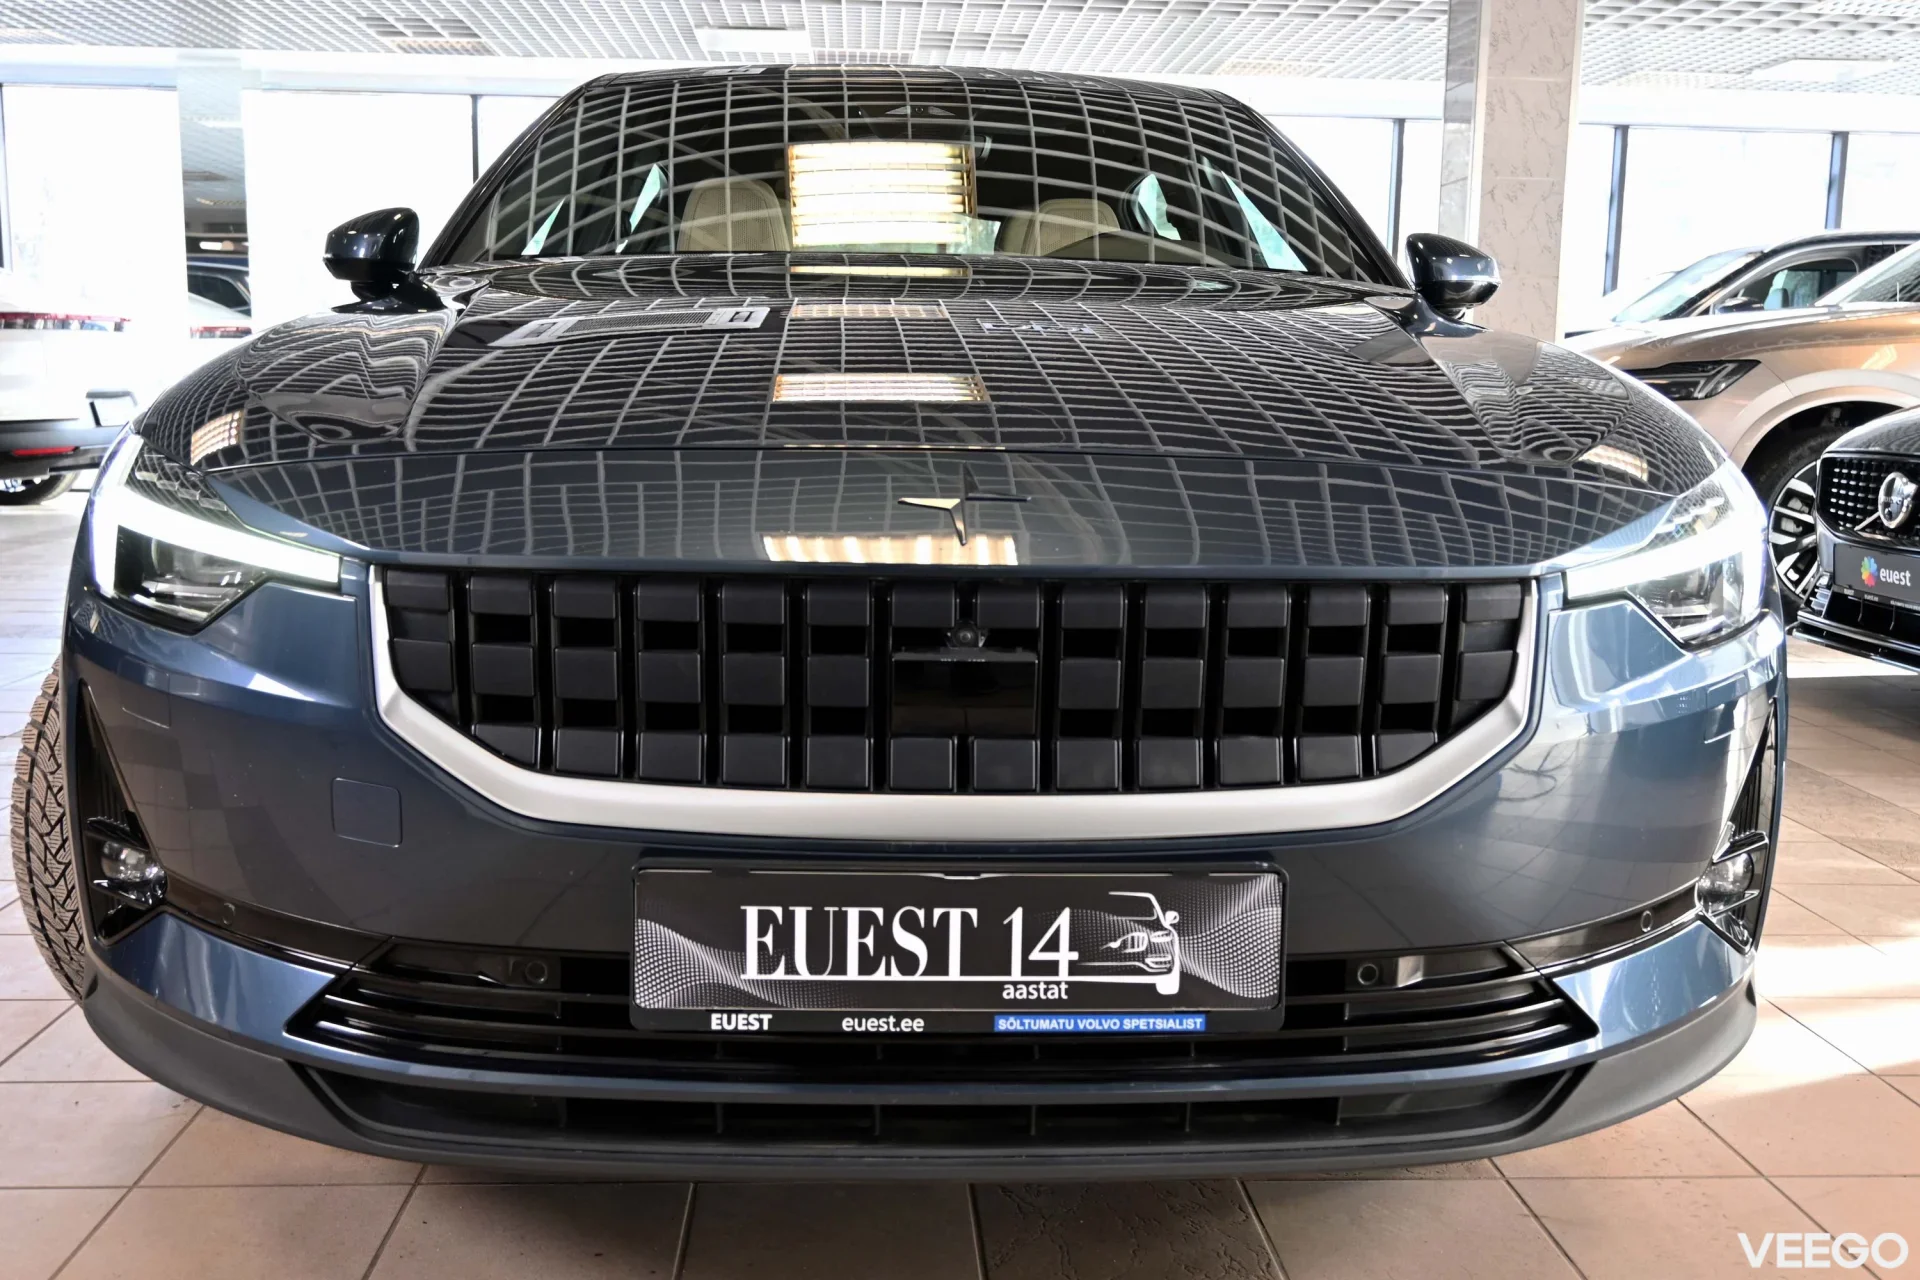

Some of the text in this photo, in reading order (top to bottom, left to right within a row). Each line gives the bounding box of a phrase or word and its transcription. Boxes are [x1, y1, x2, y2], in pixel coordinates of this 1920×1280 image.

[1879, 567, 1912, 587] euest
[740, 906, 1078, 977] EUEST 14
[1002, 982, 1069, 1000] aastat
[710, 1013, 773, 1031] EUEST
[841, 1015, 925, 1034] euest.ee
[998, 1016, 1204, 1030] SÕLTUMATU VOLVO SPETSIALIST
